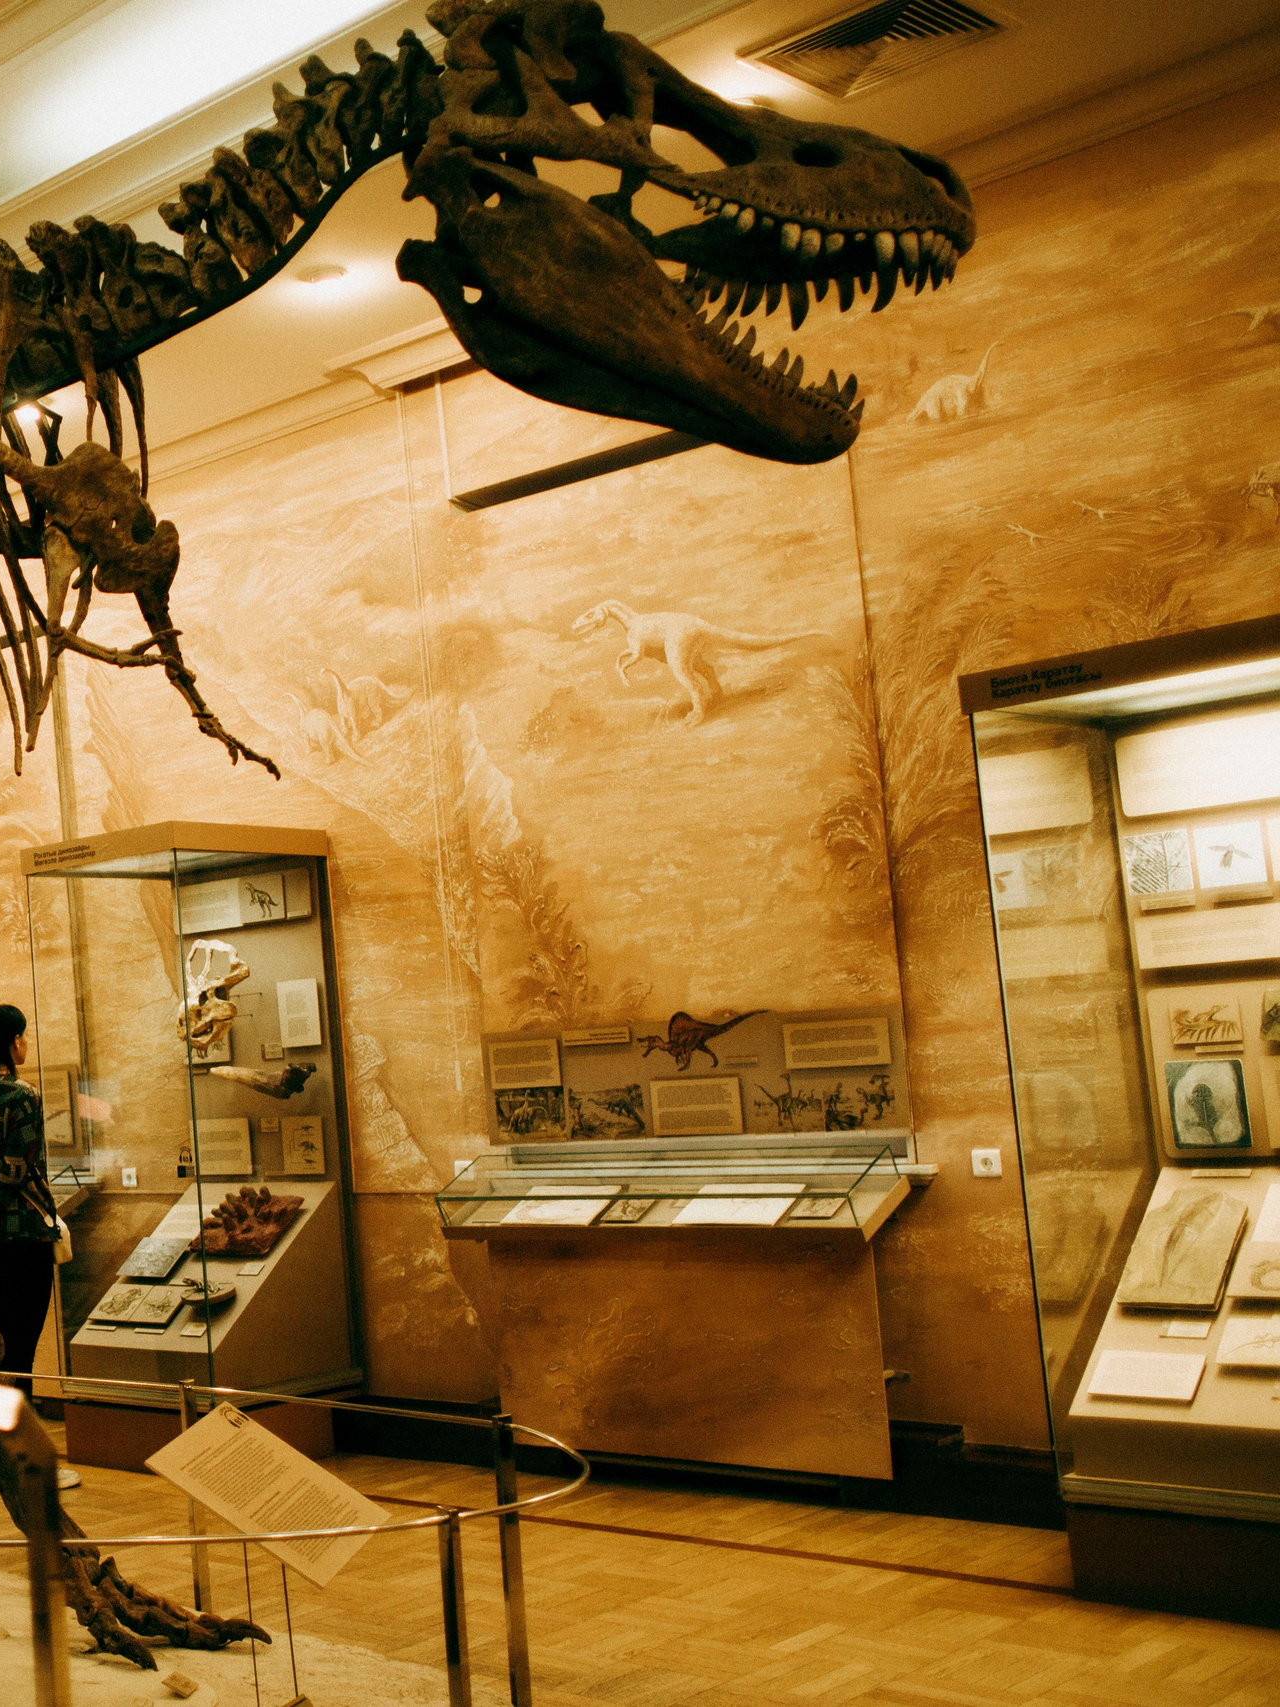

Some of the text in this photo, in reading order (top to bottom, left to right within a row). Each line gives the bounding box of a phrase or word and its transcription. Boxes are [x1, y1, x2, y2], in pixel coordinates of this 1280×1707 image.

[991, 664, 1082, 688] Биота Каратау
[992, 672, 1102, 699] Каратау биотасы
[34, 851, 57, 859] Рогатые
